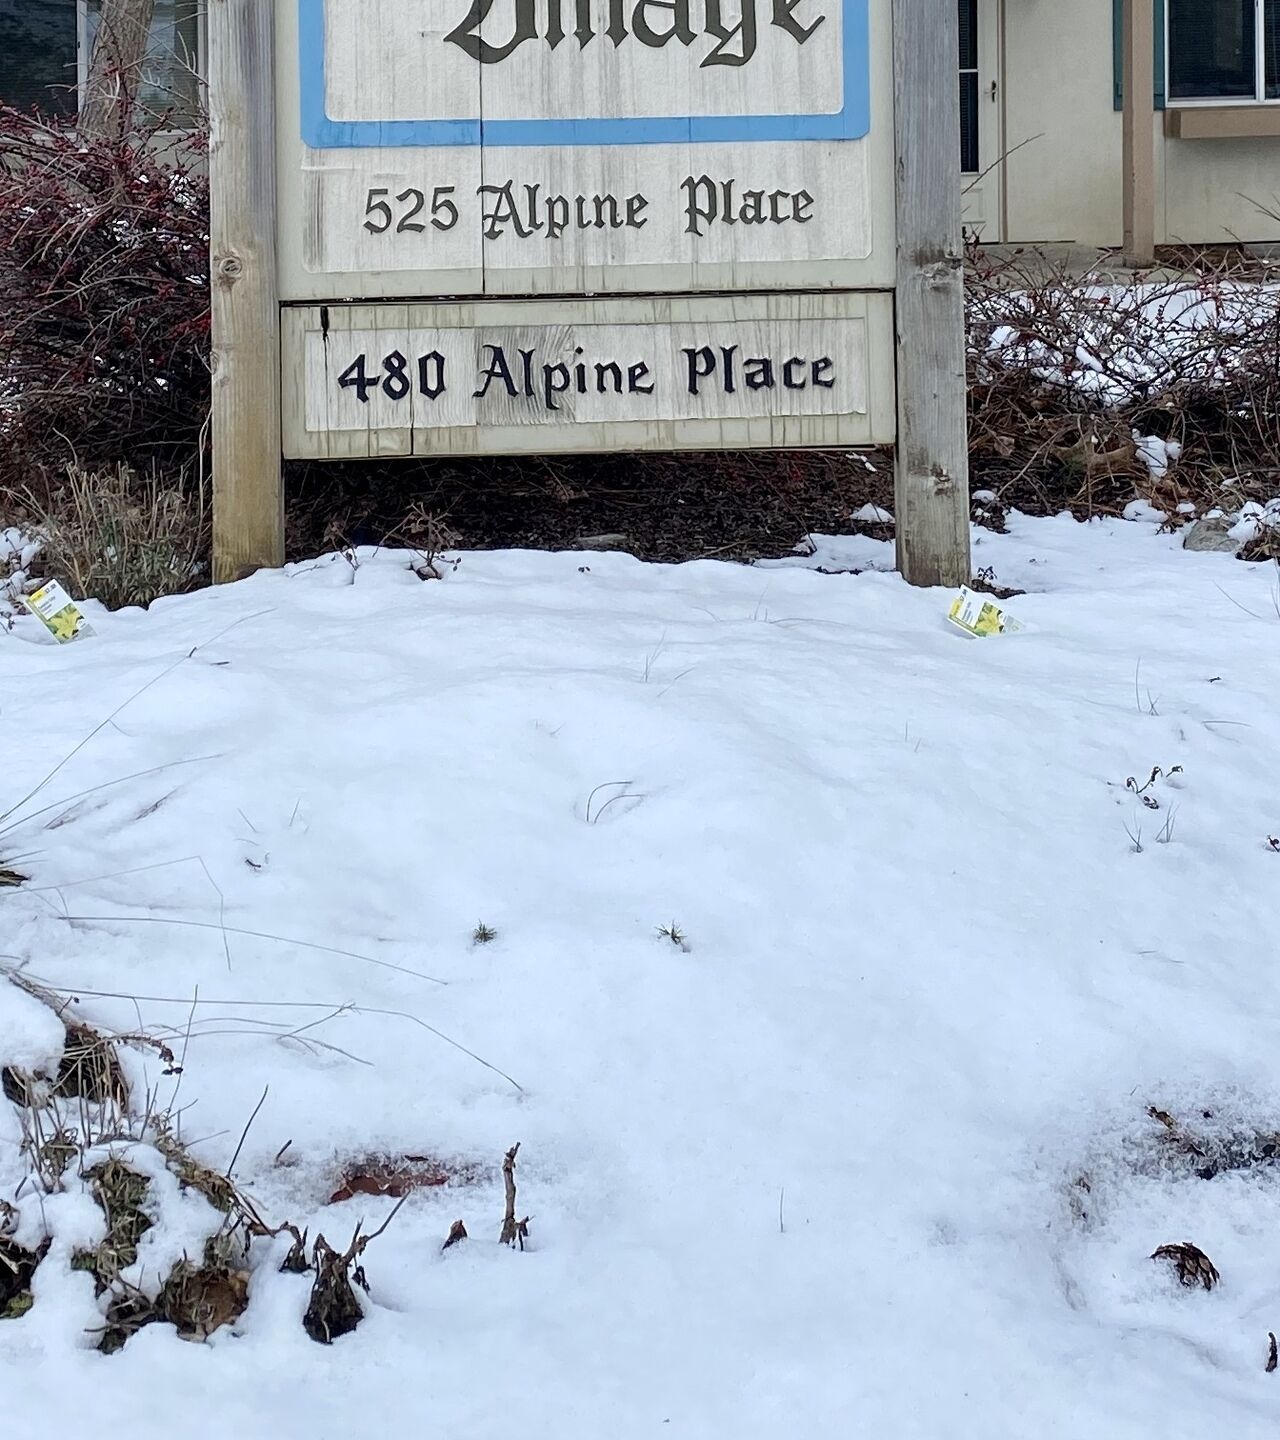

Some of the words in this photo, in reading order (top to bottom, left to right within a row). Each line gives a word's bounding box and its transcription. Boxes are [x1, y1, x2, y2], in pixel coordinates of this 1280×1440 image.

[363, 186, 459, 236] 525
[476, 179, 649, 240] Alpine
[679, 174, 815, 238] Place
[337, 349, 447, 404] 480
[472, 344, 655, 411] Alpine
[681, 344, 836, 396] Place
